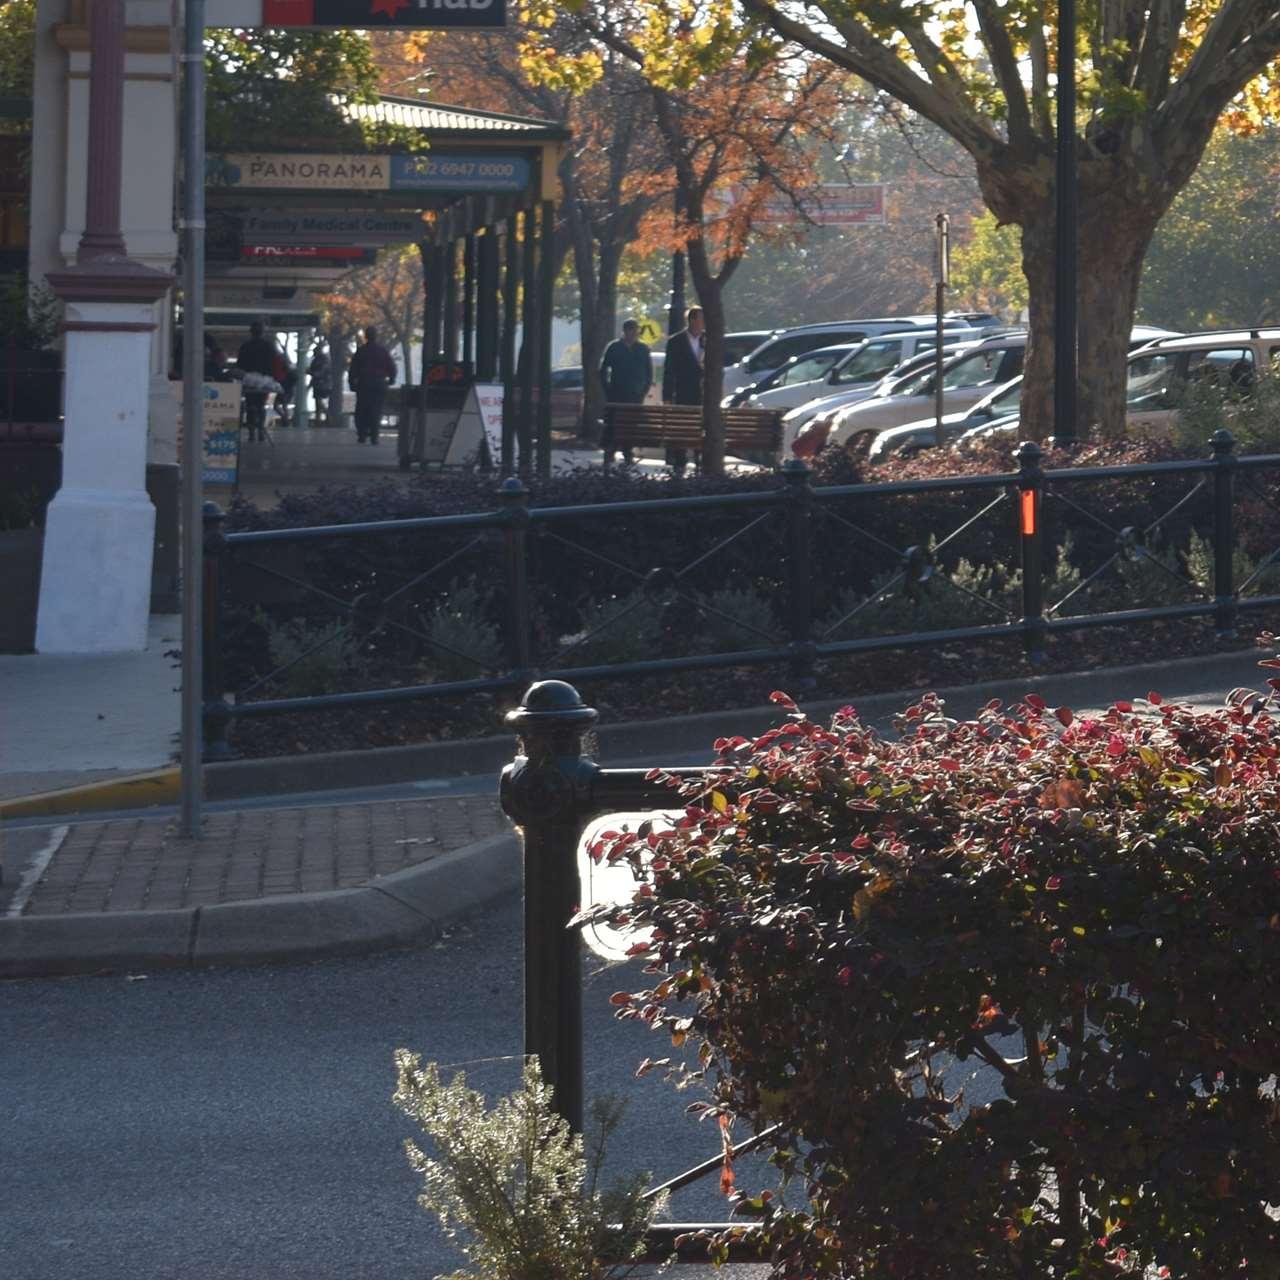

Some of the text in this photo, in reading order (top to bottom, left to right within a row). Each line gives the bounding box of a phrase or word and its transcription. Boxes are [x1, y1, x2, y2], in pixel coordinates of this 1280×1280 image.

[250, 162, 384, 179] PANORAMA
[249, 216, 413, 233] Family Medical Centre
